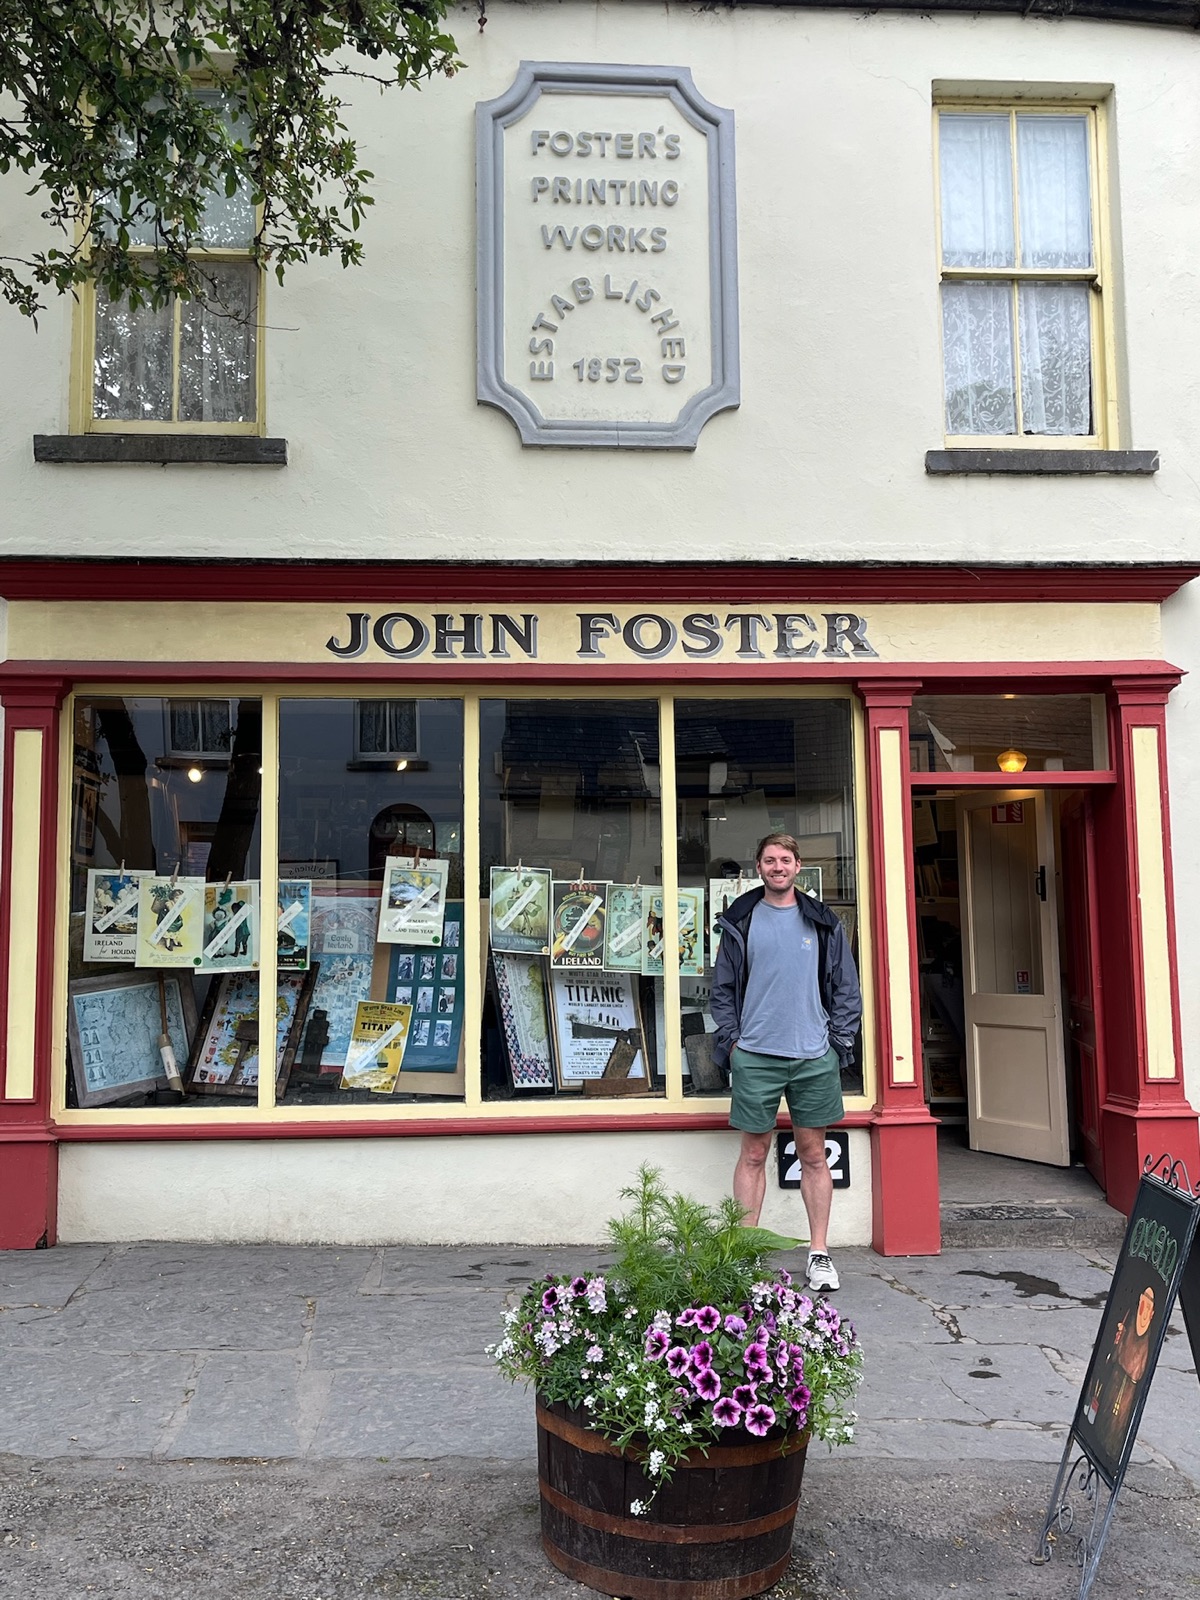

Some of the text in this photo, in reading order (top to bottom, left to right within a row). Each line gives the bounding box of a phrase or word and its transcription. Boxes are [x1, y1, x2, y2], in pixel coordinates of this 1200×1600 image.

[531, 125, 681, 159] FOSTER'S
[540, 224, 668, 253] WORKS
[530, 274, 686, 383] ESTABLISHED
[572, 357, 644, 383] 1852
[325, 612, 880, 659] JOHN FOSTER
[330, 934, 352, 943] Early
[513, 937, 547, 945] WHISKEY
[561, 957, 602, 965] IRELAND
[564, 985, 625, 1003] TITANIC
[784, 1139, 844, 1181] 22
